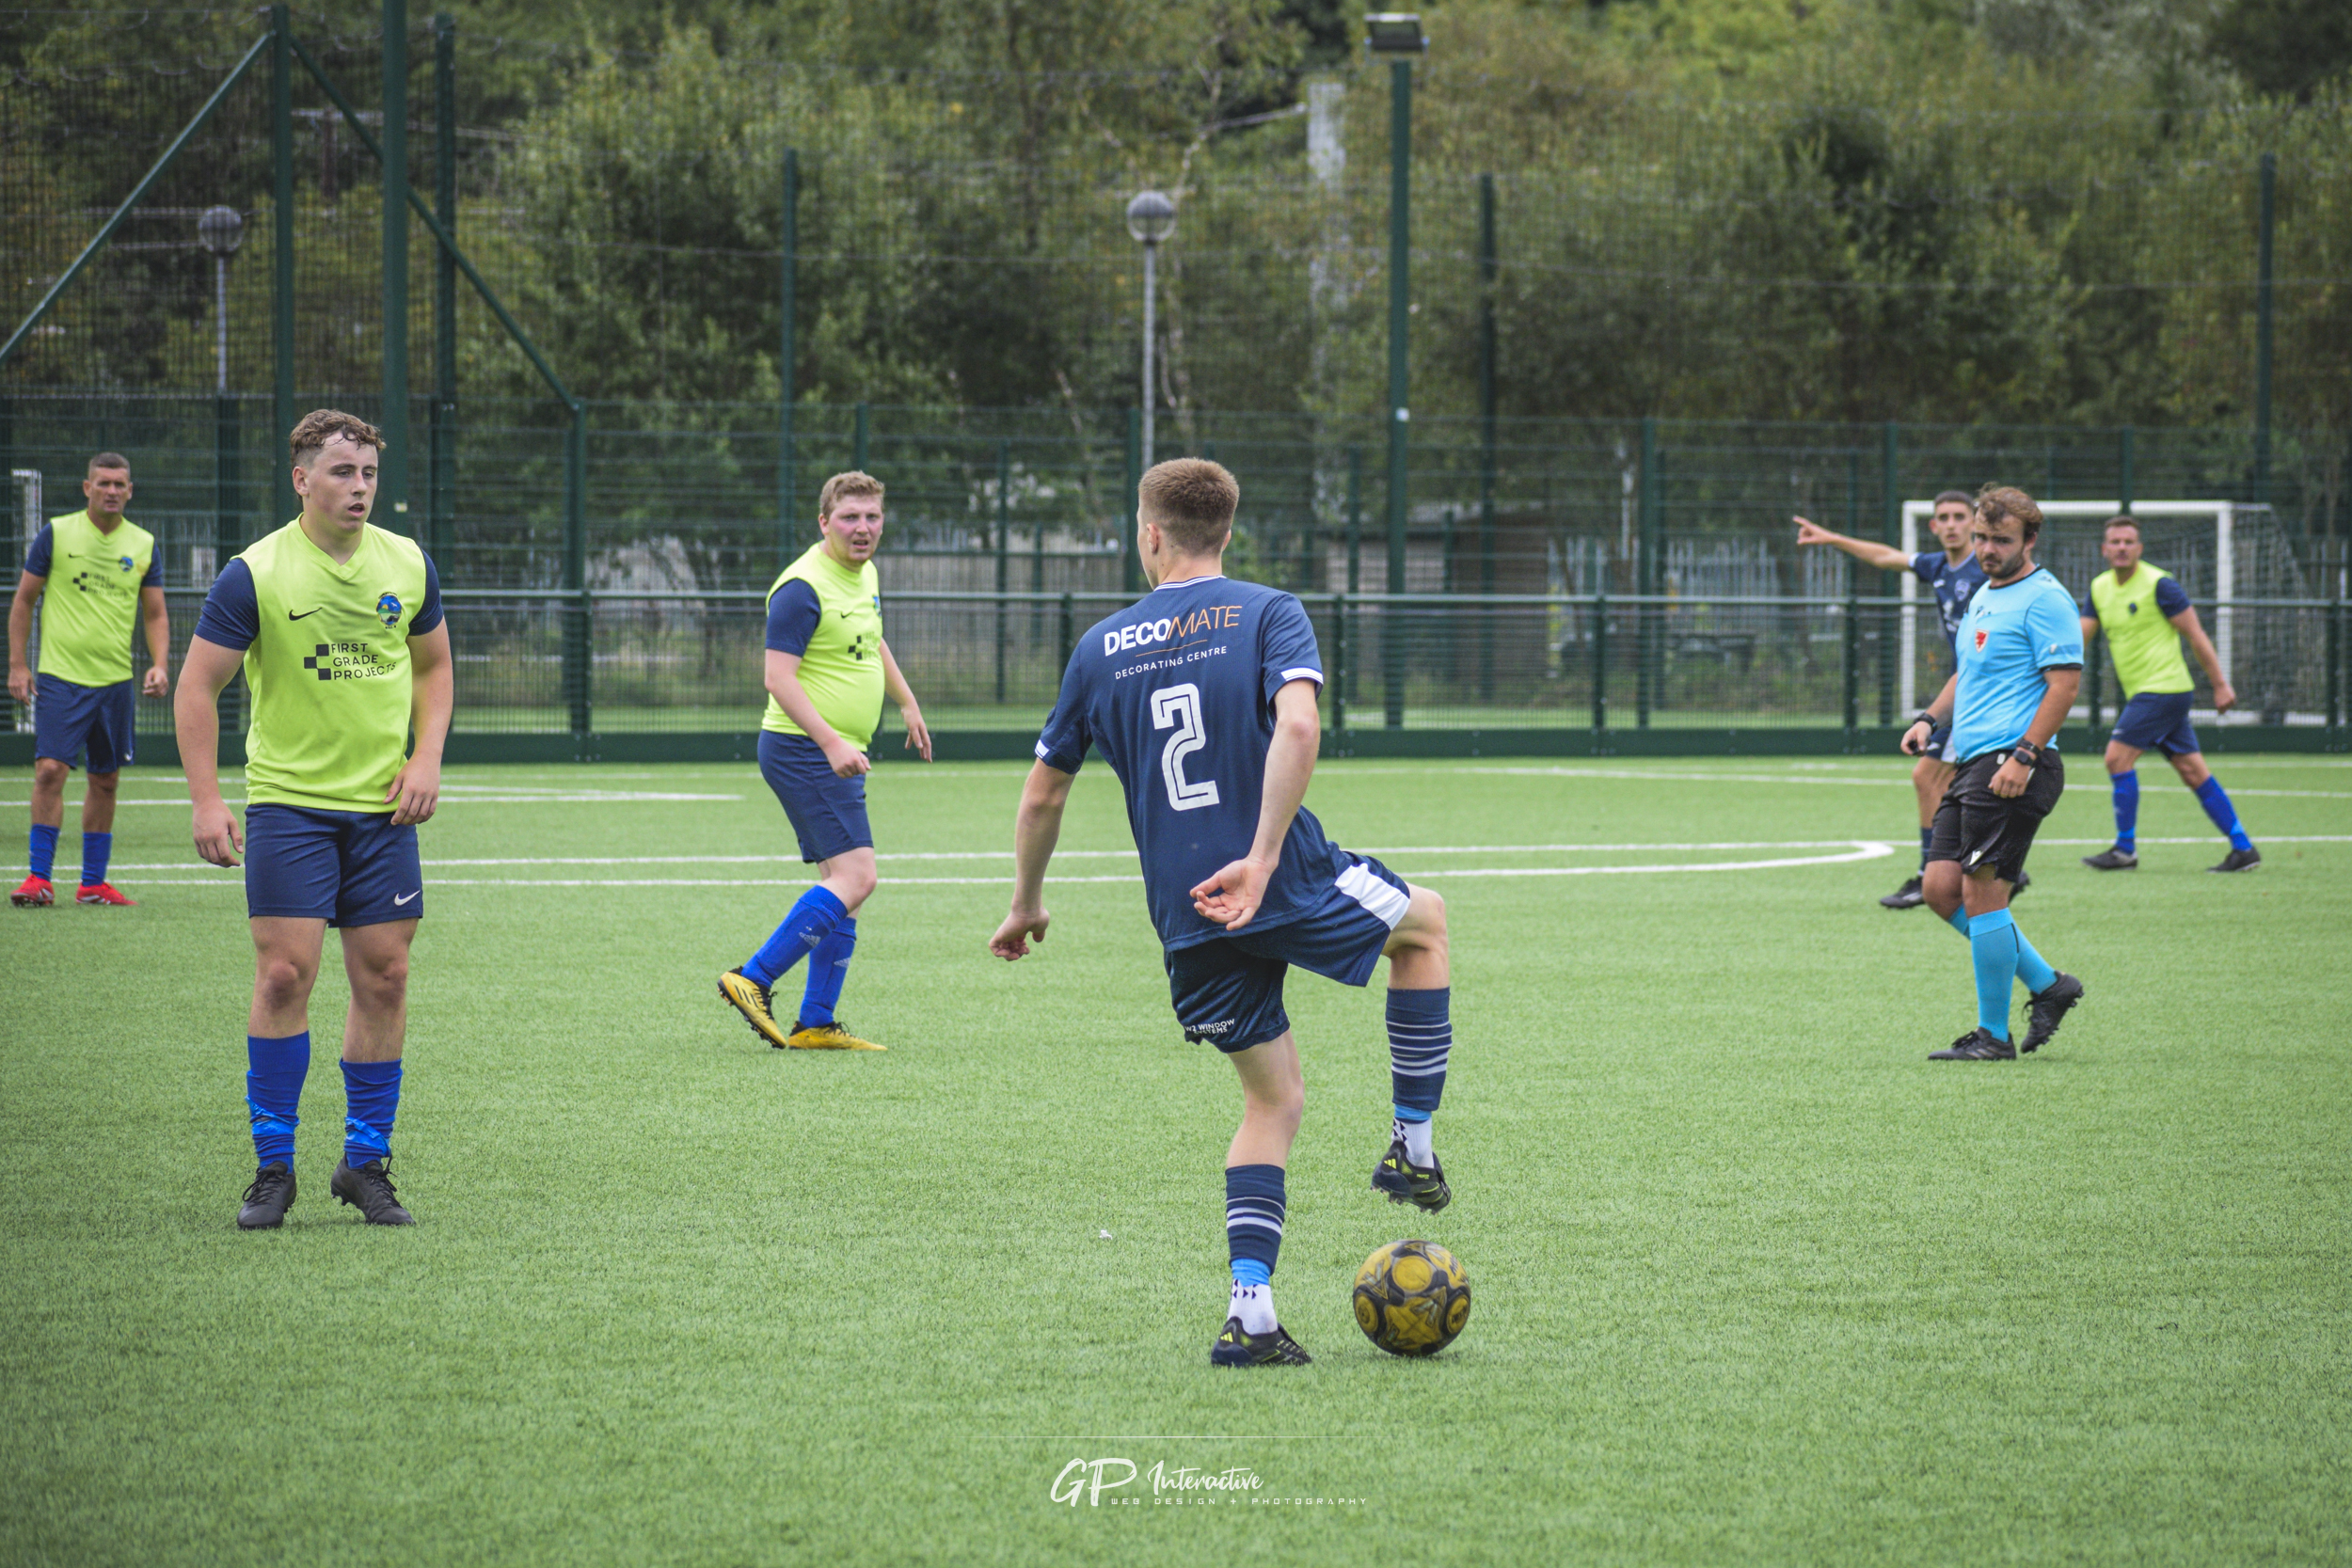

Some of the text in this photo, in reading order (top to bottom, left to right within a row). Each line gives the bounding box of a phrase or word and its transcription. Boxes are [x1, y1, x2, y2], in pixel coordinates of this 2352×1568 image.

[1104, 606, 1242, 657] DECOMATE
[331, 642, 368, 654] FIRST
[333, 655, 378, 667] GRADE
[1115, 645, 1227, 679] DECORATING CENTRE
[334, 662, 396, 680] PROJECTS
[1151, 683, 1219, 811] 2
[1198, 1019, 1235, 1031] WINDOW
